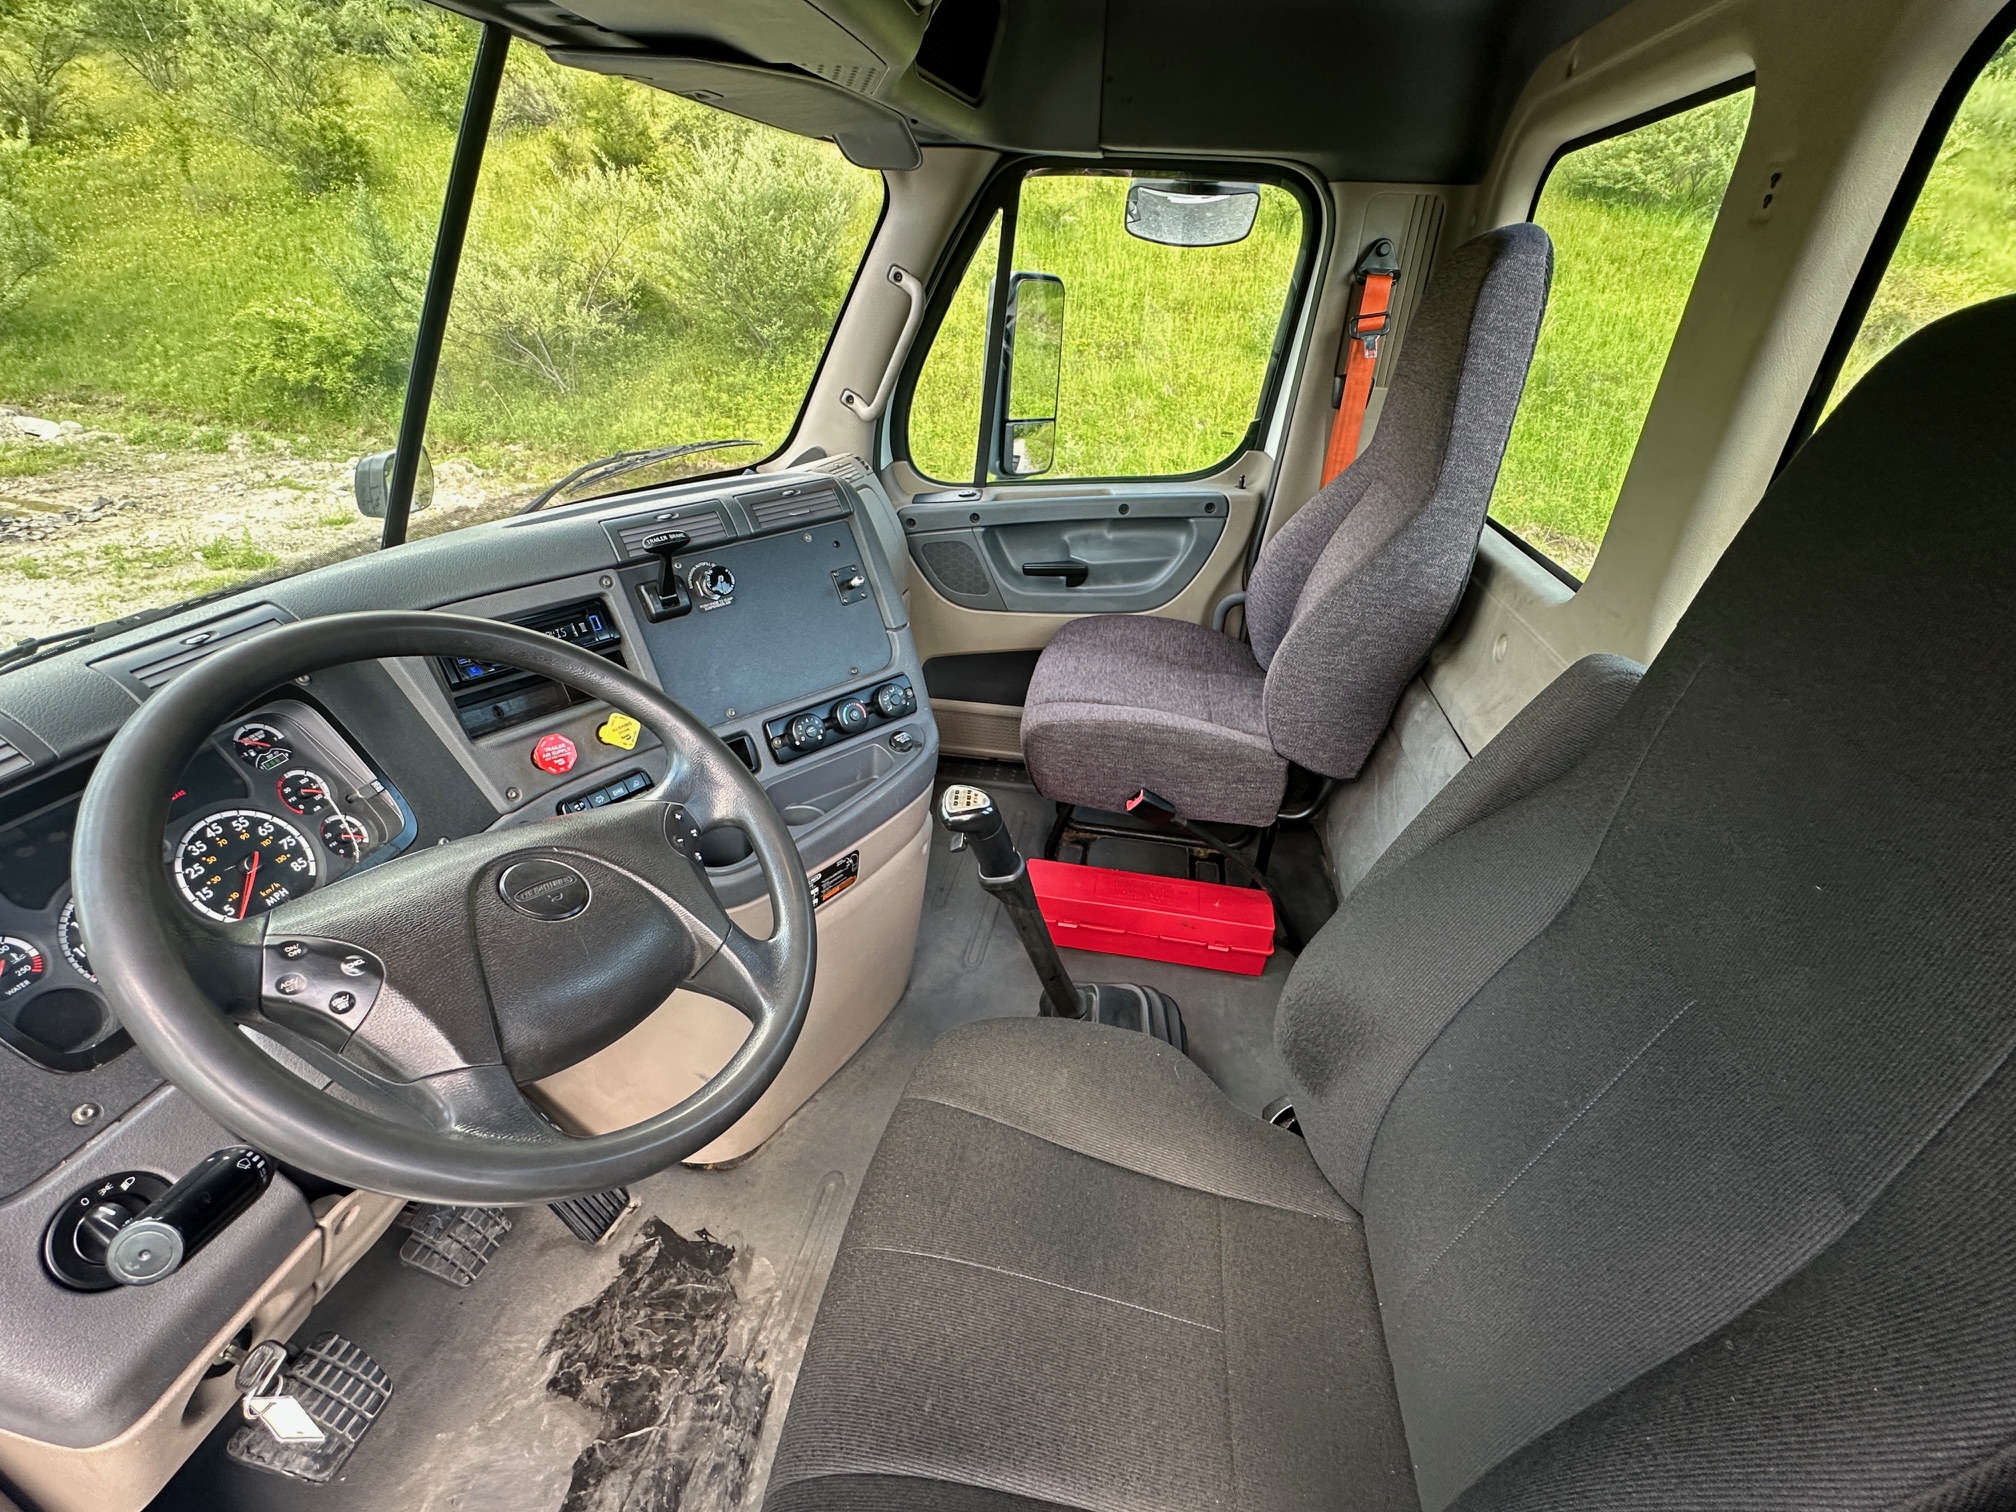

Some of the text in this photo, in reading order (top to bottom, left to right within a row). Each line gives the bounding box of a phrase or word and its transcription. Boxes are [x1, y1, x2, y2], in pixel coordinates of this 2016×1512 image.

[646, 535, 668, 545] TRAILER
[544, 743, 566, 753] TRAILER
[551, 747, 571, 756] SUPPLY
[206, 822, 223, 838] 45
[231, 816, 250, 832] 55
[258, 822, 275, 836] 65
[240, 832, 250, 840] 90
[187, 840, 207, 856] 35
[217, 838, 228, 847] 70
[261, 838, 272, 847] 110
[278, 835, 297, 850] 75
[206, 856, 217, 865] 50
[275, 854, 287, 864] 130
[290, 857, 308, 872] 85
[185, 863, 205, 879] 25
[211, 875, 222, 884] 30
[196, 886, 214, 901] 15
[260, 882, 281, 897] km/h
[230, 892, 240, 900] 10
[265, 887, 289, 907] MPH
[223, 904, 236, 916] 5
[284, 943, 300, 953] ON/
[288, 948, 302, 957] OFF
[15, 964, 32, 977] 250
[5, 979, 31, 996] WATER
[280, 977, 299, 990] ACC/
